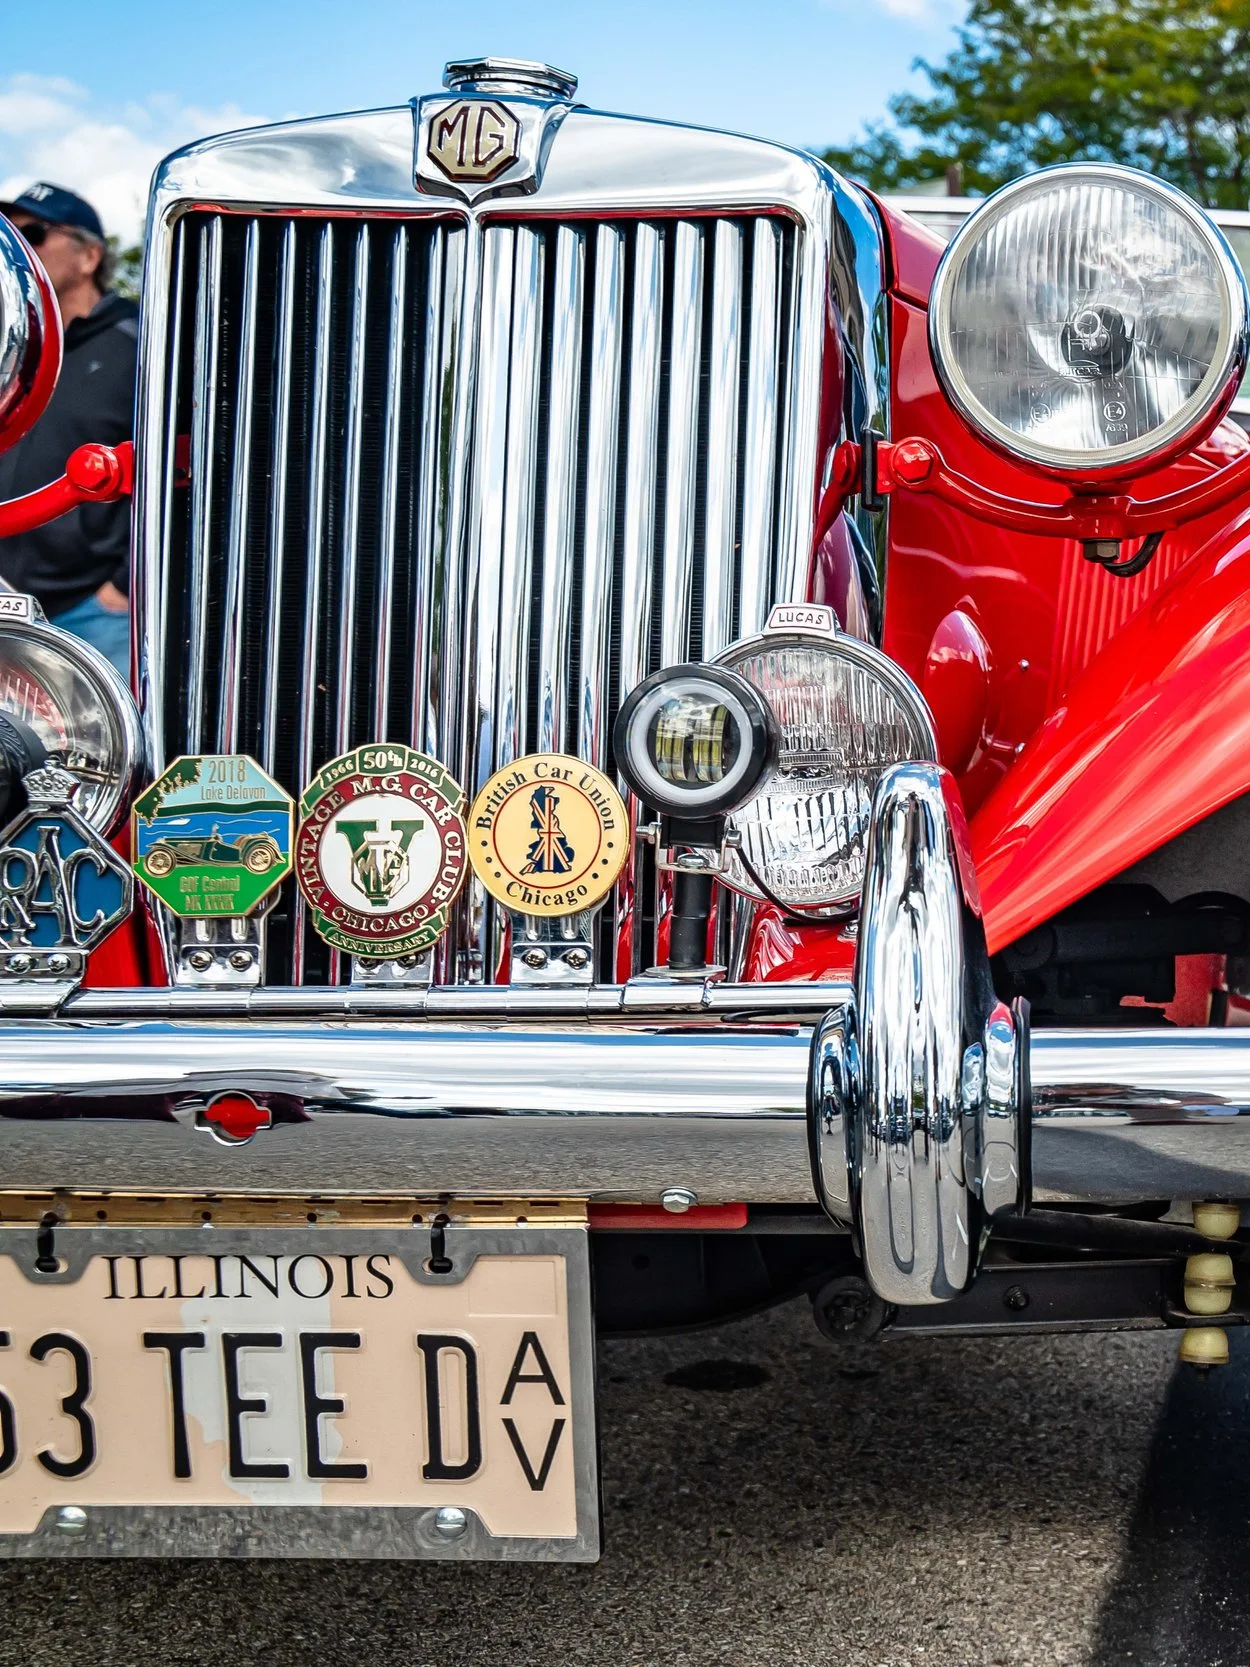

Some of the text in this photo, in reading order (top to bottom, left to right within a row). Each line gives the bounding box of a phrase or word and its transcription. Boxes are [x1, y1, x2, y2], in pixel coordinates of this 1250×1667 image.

[438, 106, 505, 167] MG
[778, 612, 824, 625] LUCAS
[208, 760, 246, 783] 2018
[325, 760, 354, 782] 1966
[363, 750, 403, 769] 50th
[410, 758, 440, 778] 2016
[201, 784, 266, 801] Lake Delavan
[476, 762, 615, 831] British Car Union
[301, 791, 345, 903] VINTAGE
[409, 783, 453, 826] CAR
[506, 880, 588, 906] Chicago
[331, 903, 429, 932] CHICAGO
[328, 931, 430, 953] ANNIVERSARY
[102, 1254, 394, 1299] ILLINOIS
[0, 1330, 480, 1480] 3 TEE D
